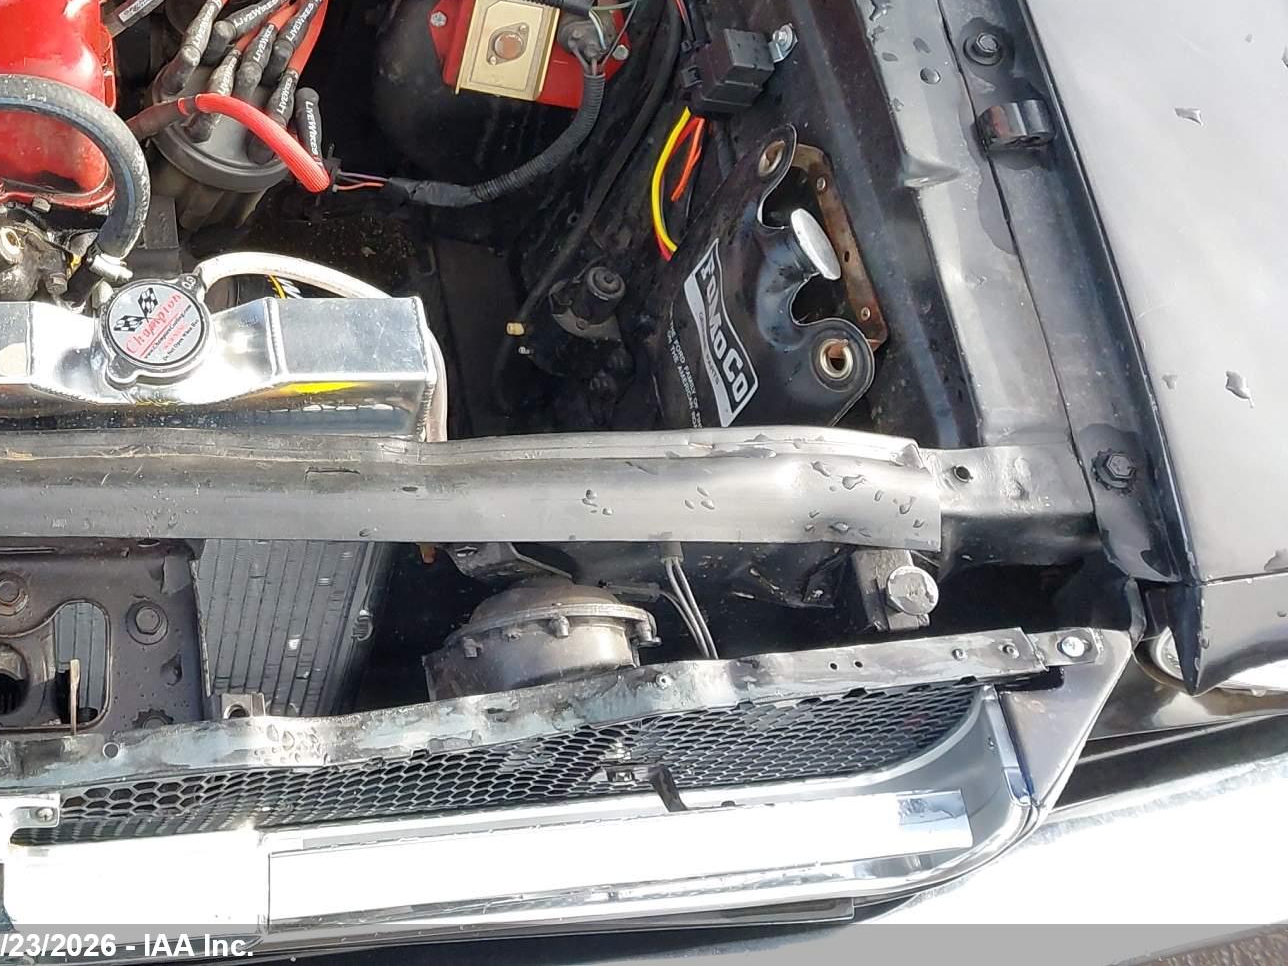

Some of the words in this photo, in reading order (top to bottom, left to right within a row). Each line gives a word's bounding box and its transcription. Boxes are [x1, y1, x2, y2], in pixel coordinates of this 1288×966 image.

[126, 294, 182, 354] Champion
[673, 339, 686, 364] FORD
[684, 365, 697, 395] FAMILY
[677, 365, 694, 410] AMERICAN
